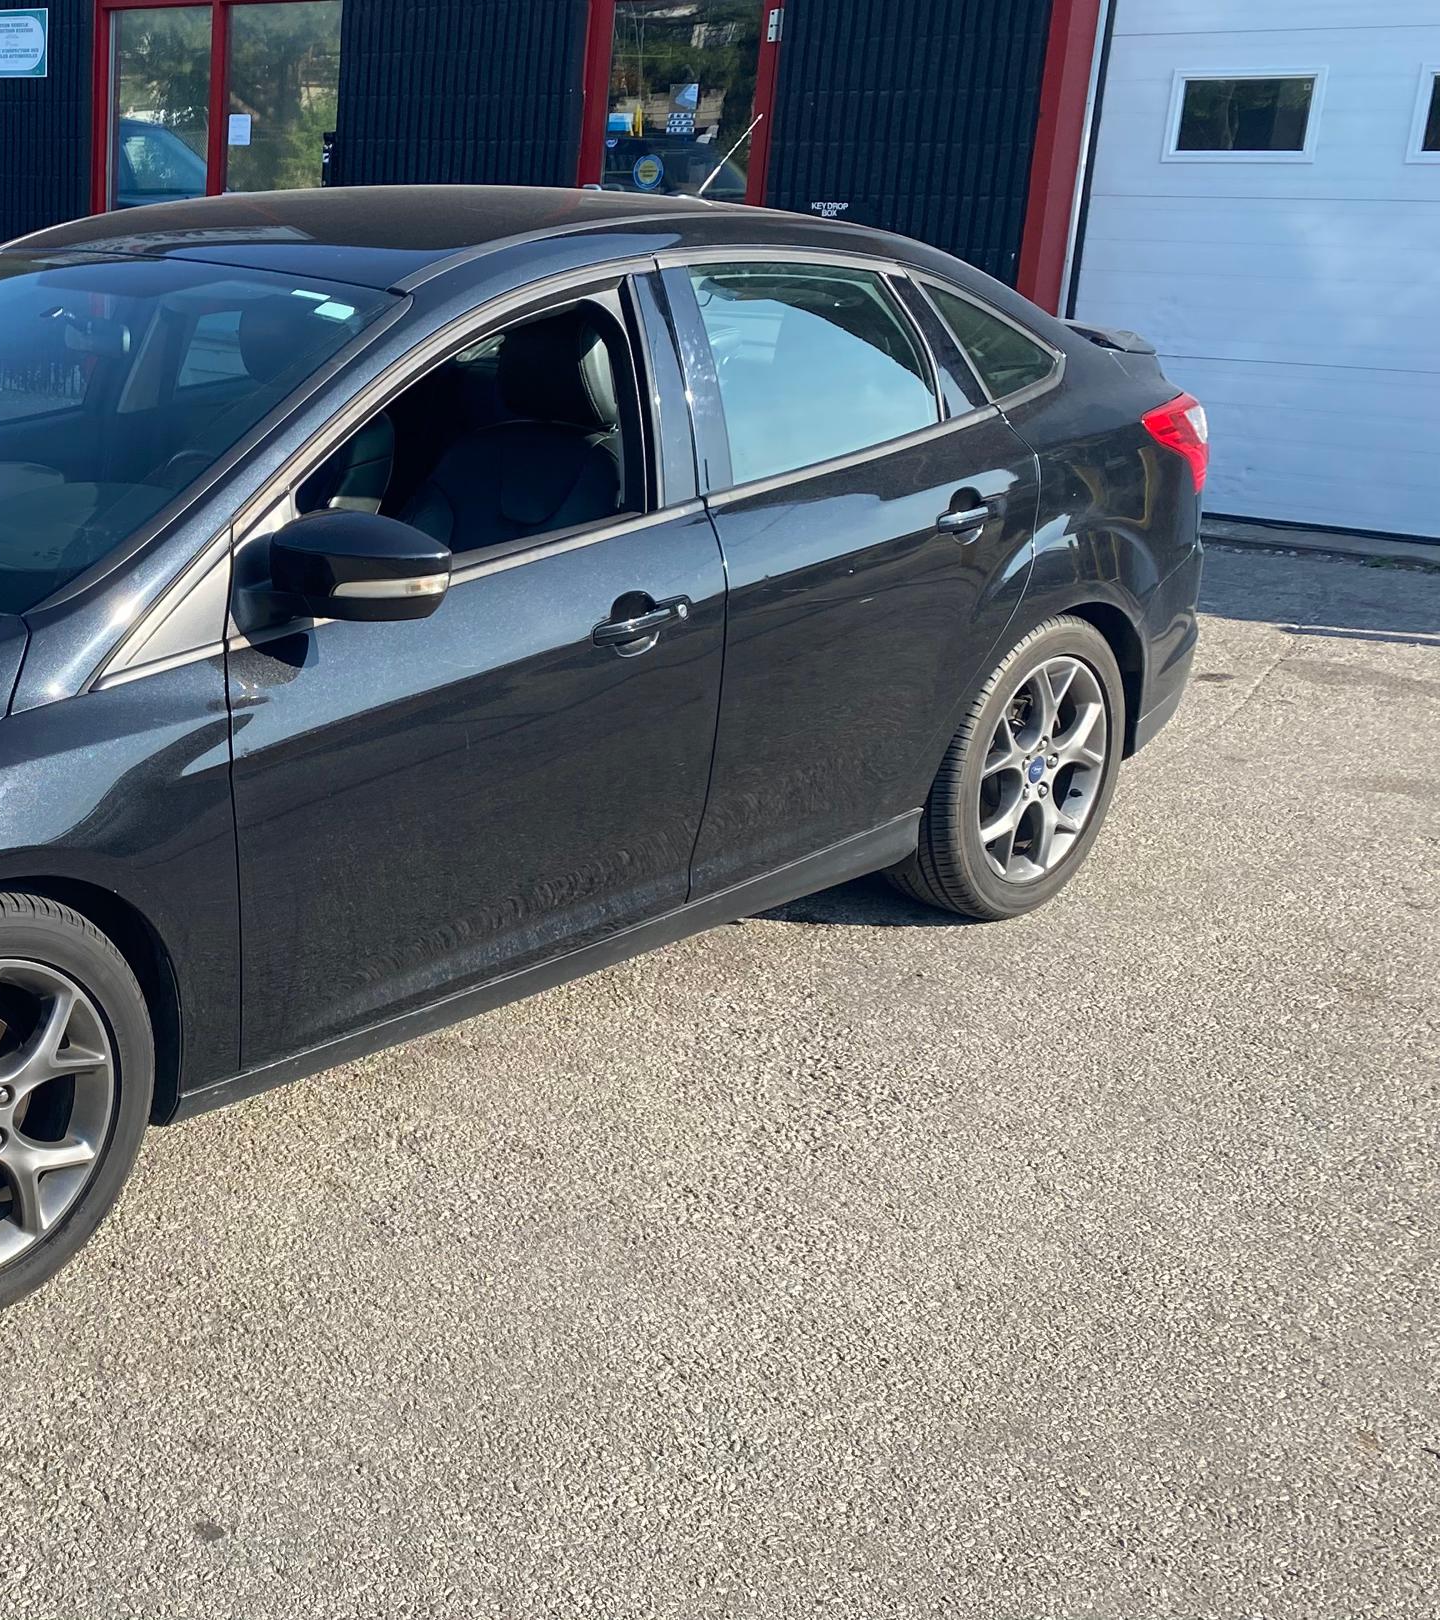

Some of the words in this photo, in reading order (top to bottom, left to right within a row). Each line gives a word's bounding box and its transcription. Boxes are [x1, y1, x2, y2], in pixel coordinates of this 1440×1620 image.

[811, 202, 826, 210] KEY
[827, 202, 849, 210] DROP
[821, 209, 838, 217] BOX
